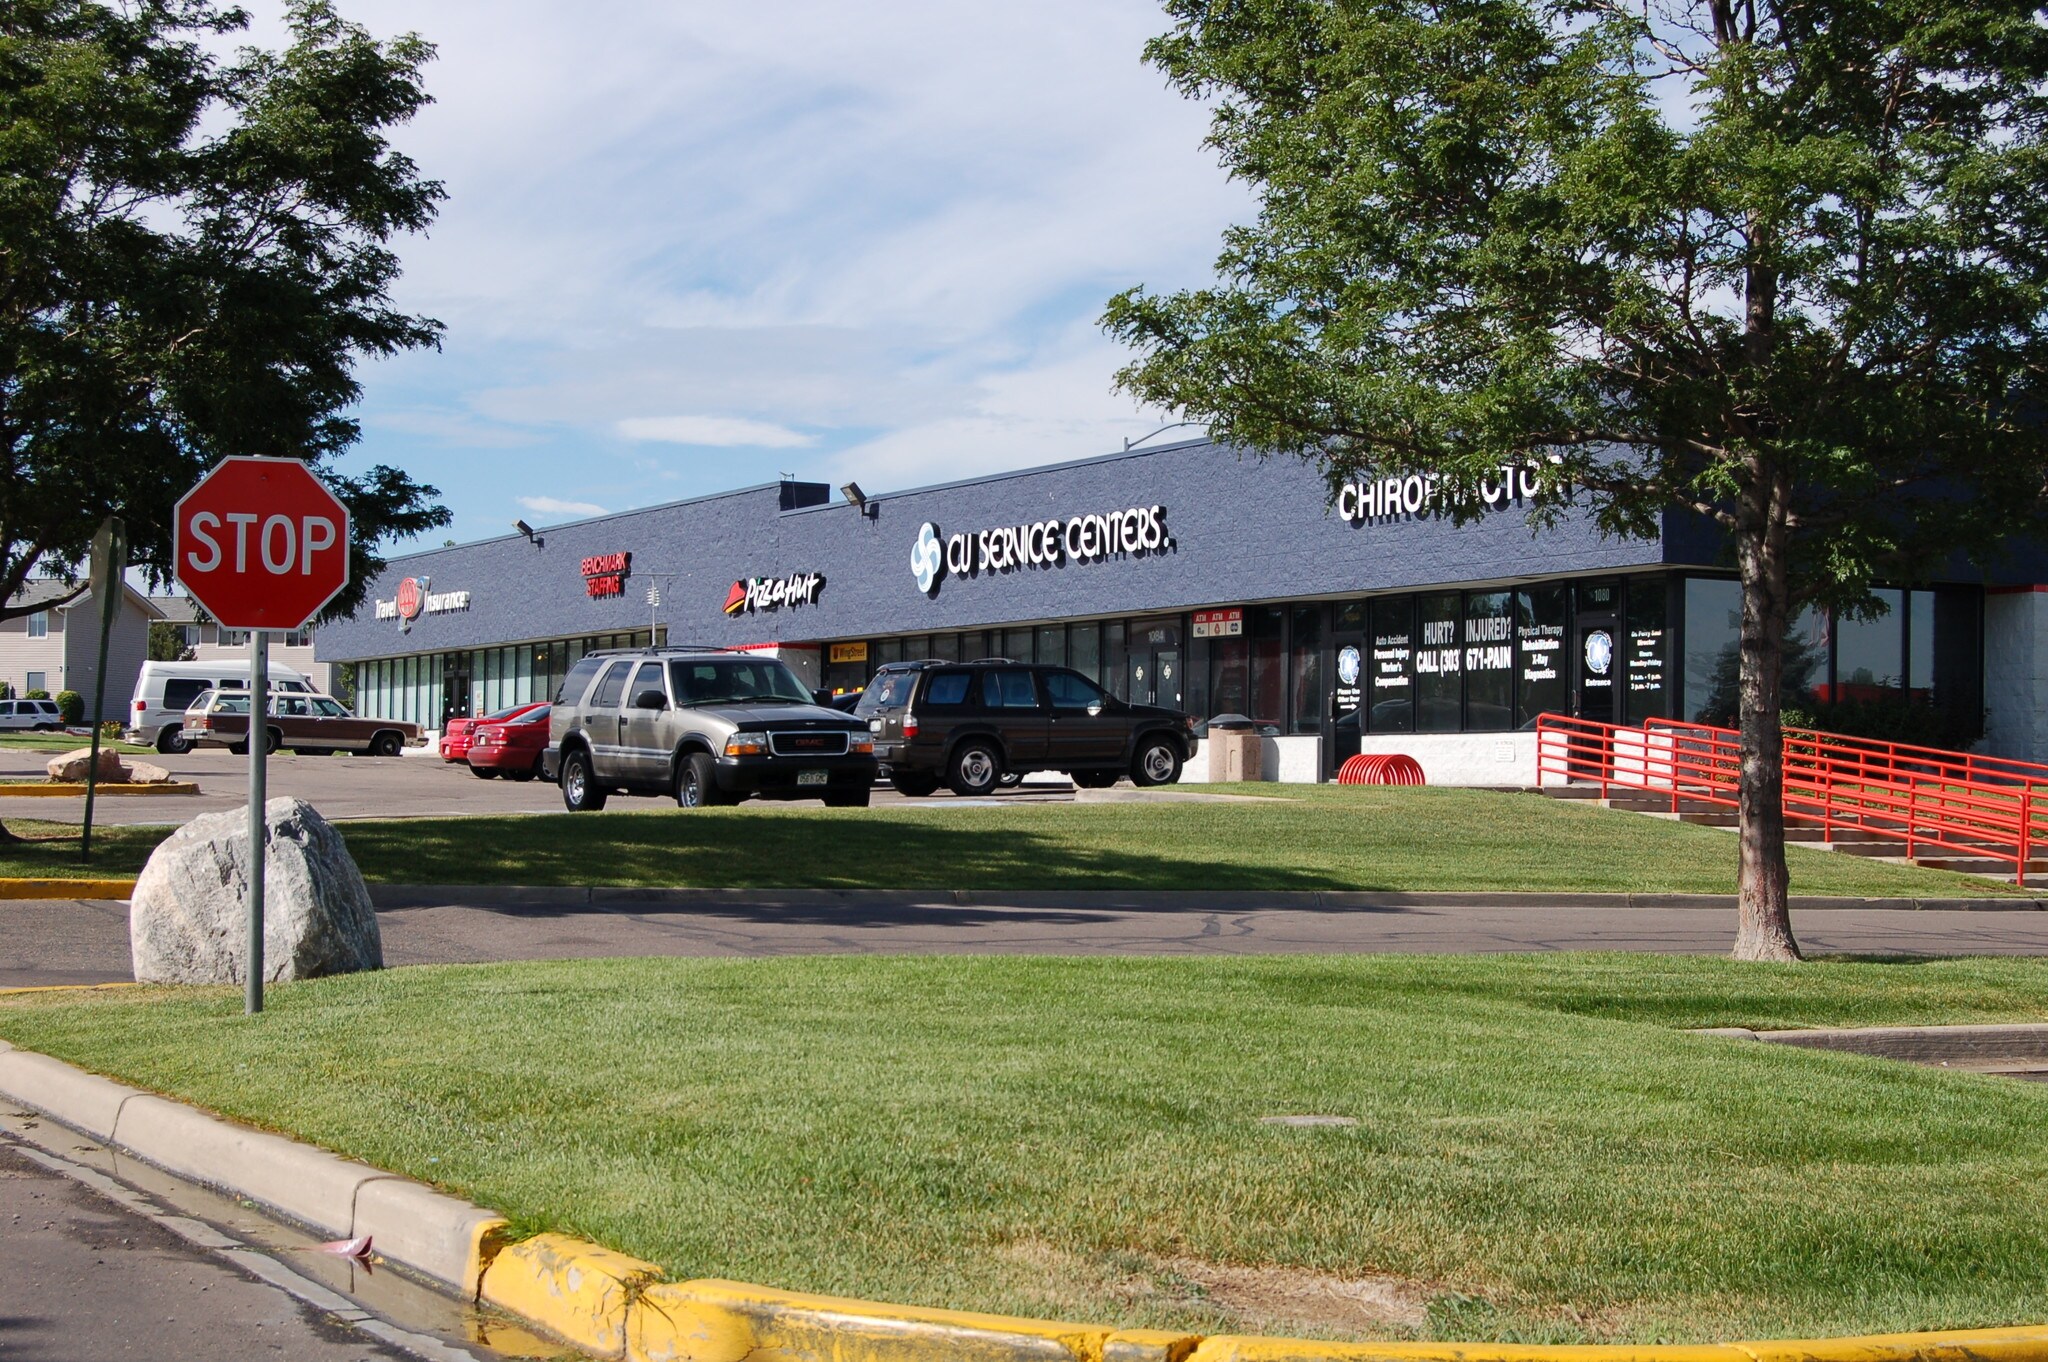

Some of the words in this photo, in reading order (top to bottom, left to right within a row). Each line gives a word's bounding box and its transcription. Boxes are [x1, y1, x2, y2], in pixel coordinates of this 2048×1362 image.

[1339, 455, 1563, 522] CHIROPCTO
[188, 511, 336, 576] STOP
[947, 533, 972, 574] CU
[978, 520, 1059, 570] SERVICE
[581, 551, 627, 577] BENCHMARK
[585, 576, 620, 597] STAFFING
[744, 577, 785, 612] Pizza
[784, 572, 820, 607] Hut
[375, 596, 398, 619] Travel
[423, 590, 468, 613] Insurance
[1195, 614, 1207, 623] ATM
[1212, 612, 1223, 621] ATM
[1228, 611, 1240, 620] ATM
[1424, 620, 1455, 645] HURT?
[1465, 616, 1512, 643] INJURED?
[1518, 625, 1540, 639] Physical
[1541, 624, 1564, 637] Therapy
[1375, 635, 1387, 646] Auto
[1387, 634, 1409, 645] Accident
[1374, 648, 1395, 660] Personal
[1395, 648, 1410, 661] Injury
[1416, 650, 1439, 674] CALL
[1465, 645, 1512, 671] 671-PAIN
[1532, 653, 1549, 667] X-Ray
[1381, 662, 1402, 673] Worker's
[1375, 675, 1409, 689] Compensation
[1524, 668, 1556, 682] Diagnostics
[1585, 679, 1612, 687] Entrance
